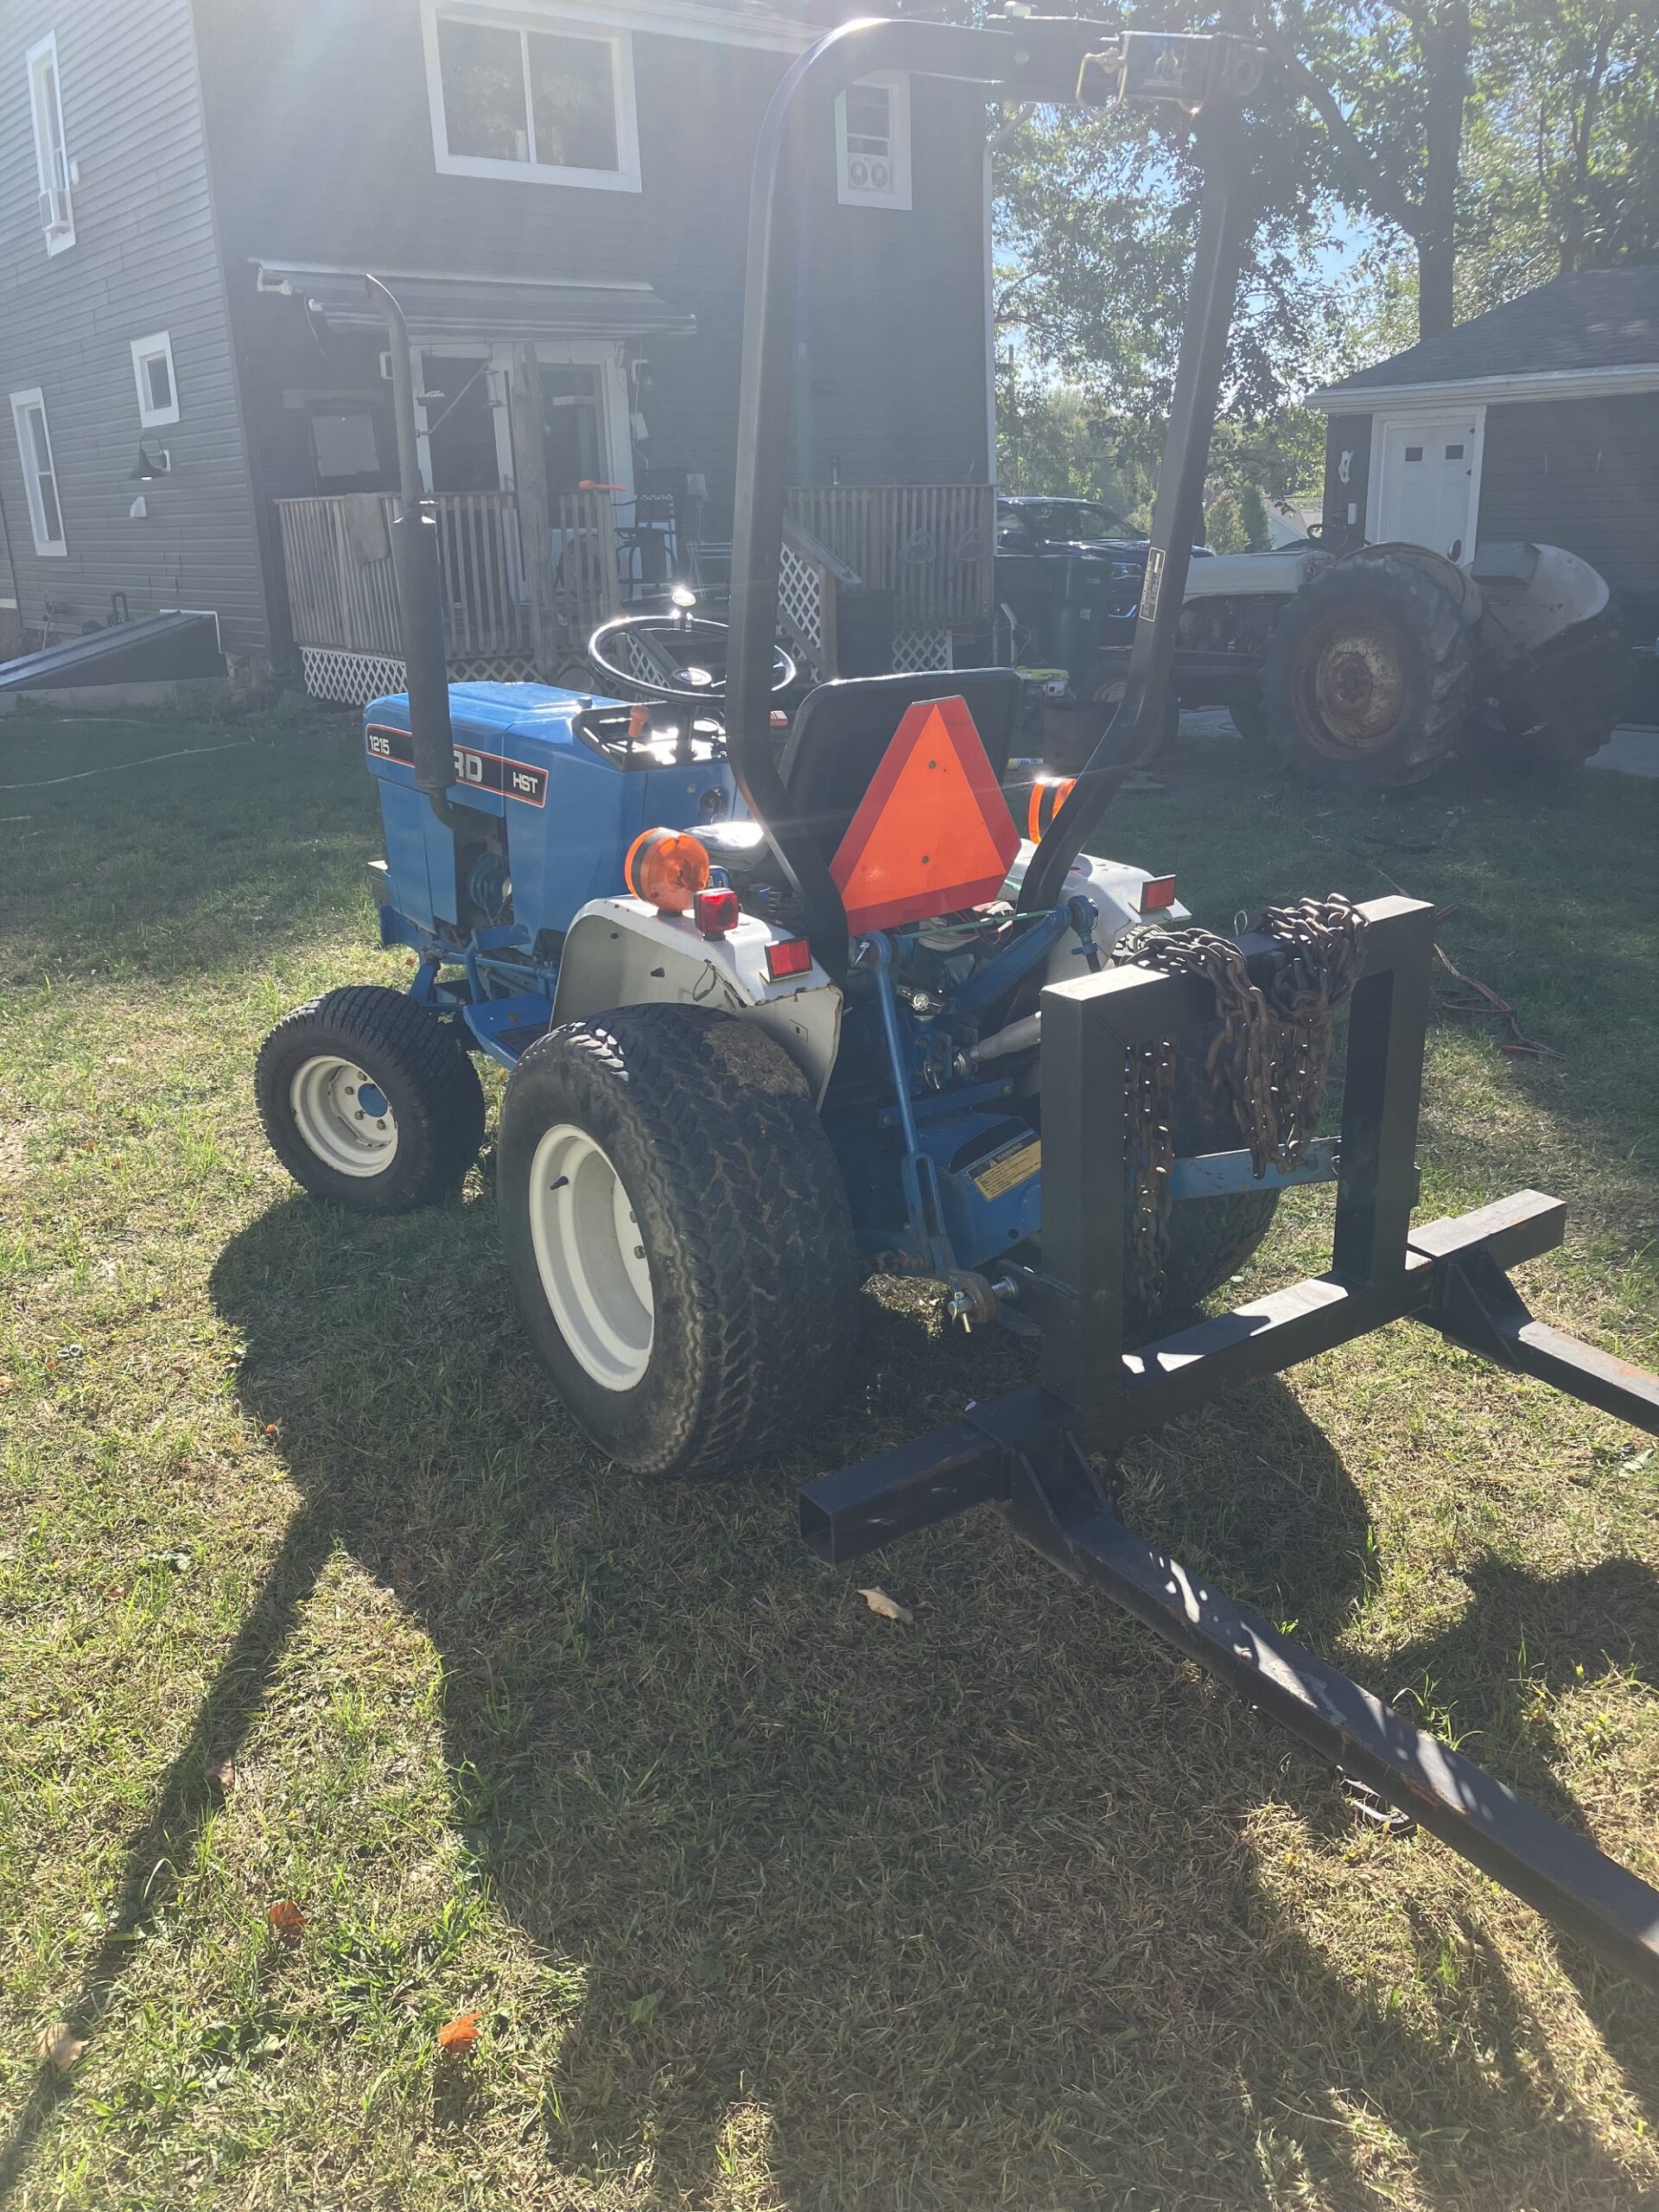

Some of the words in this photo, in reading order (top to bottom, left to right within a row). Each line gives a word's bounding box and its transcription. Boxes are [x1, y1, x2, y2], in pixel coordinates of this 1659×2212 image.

[369, 735, 390, 755] 1215
[454, 751, 482, 783] RD
[512, 772, 538, 794] HST
[995, 1142, 1023, 1161] WARNING
